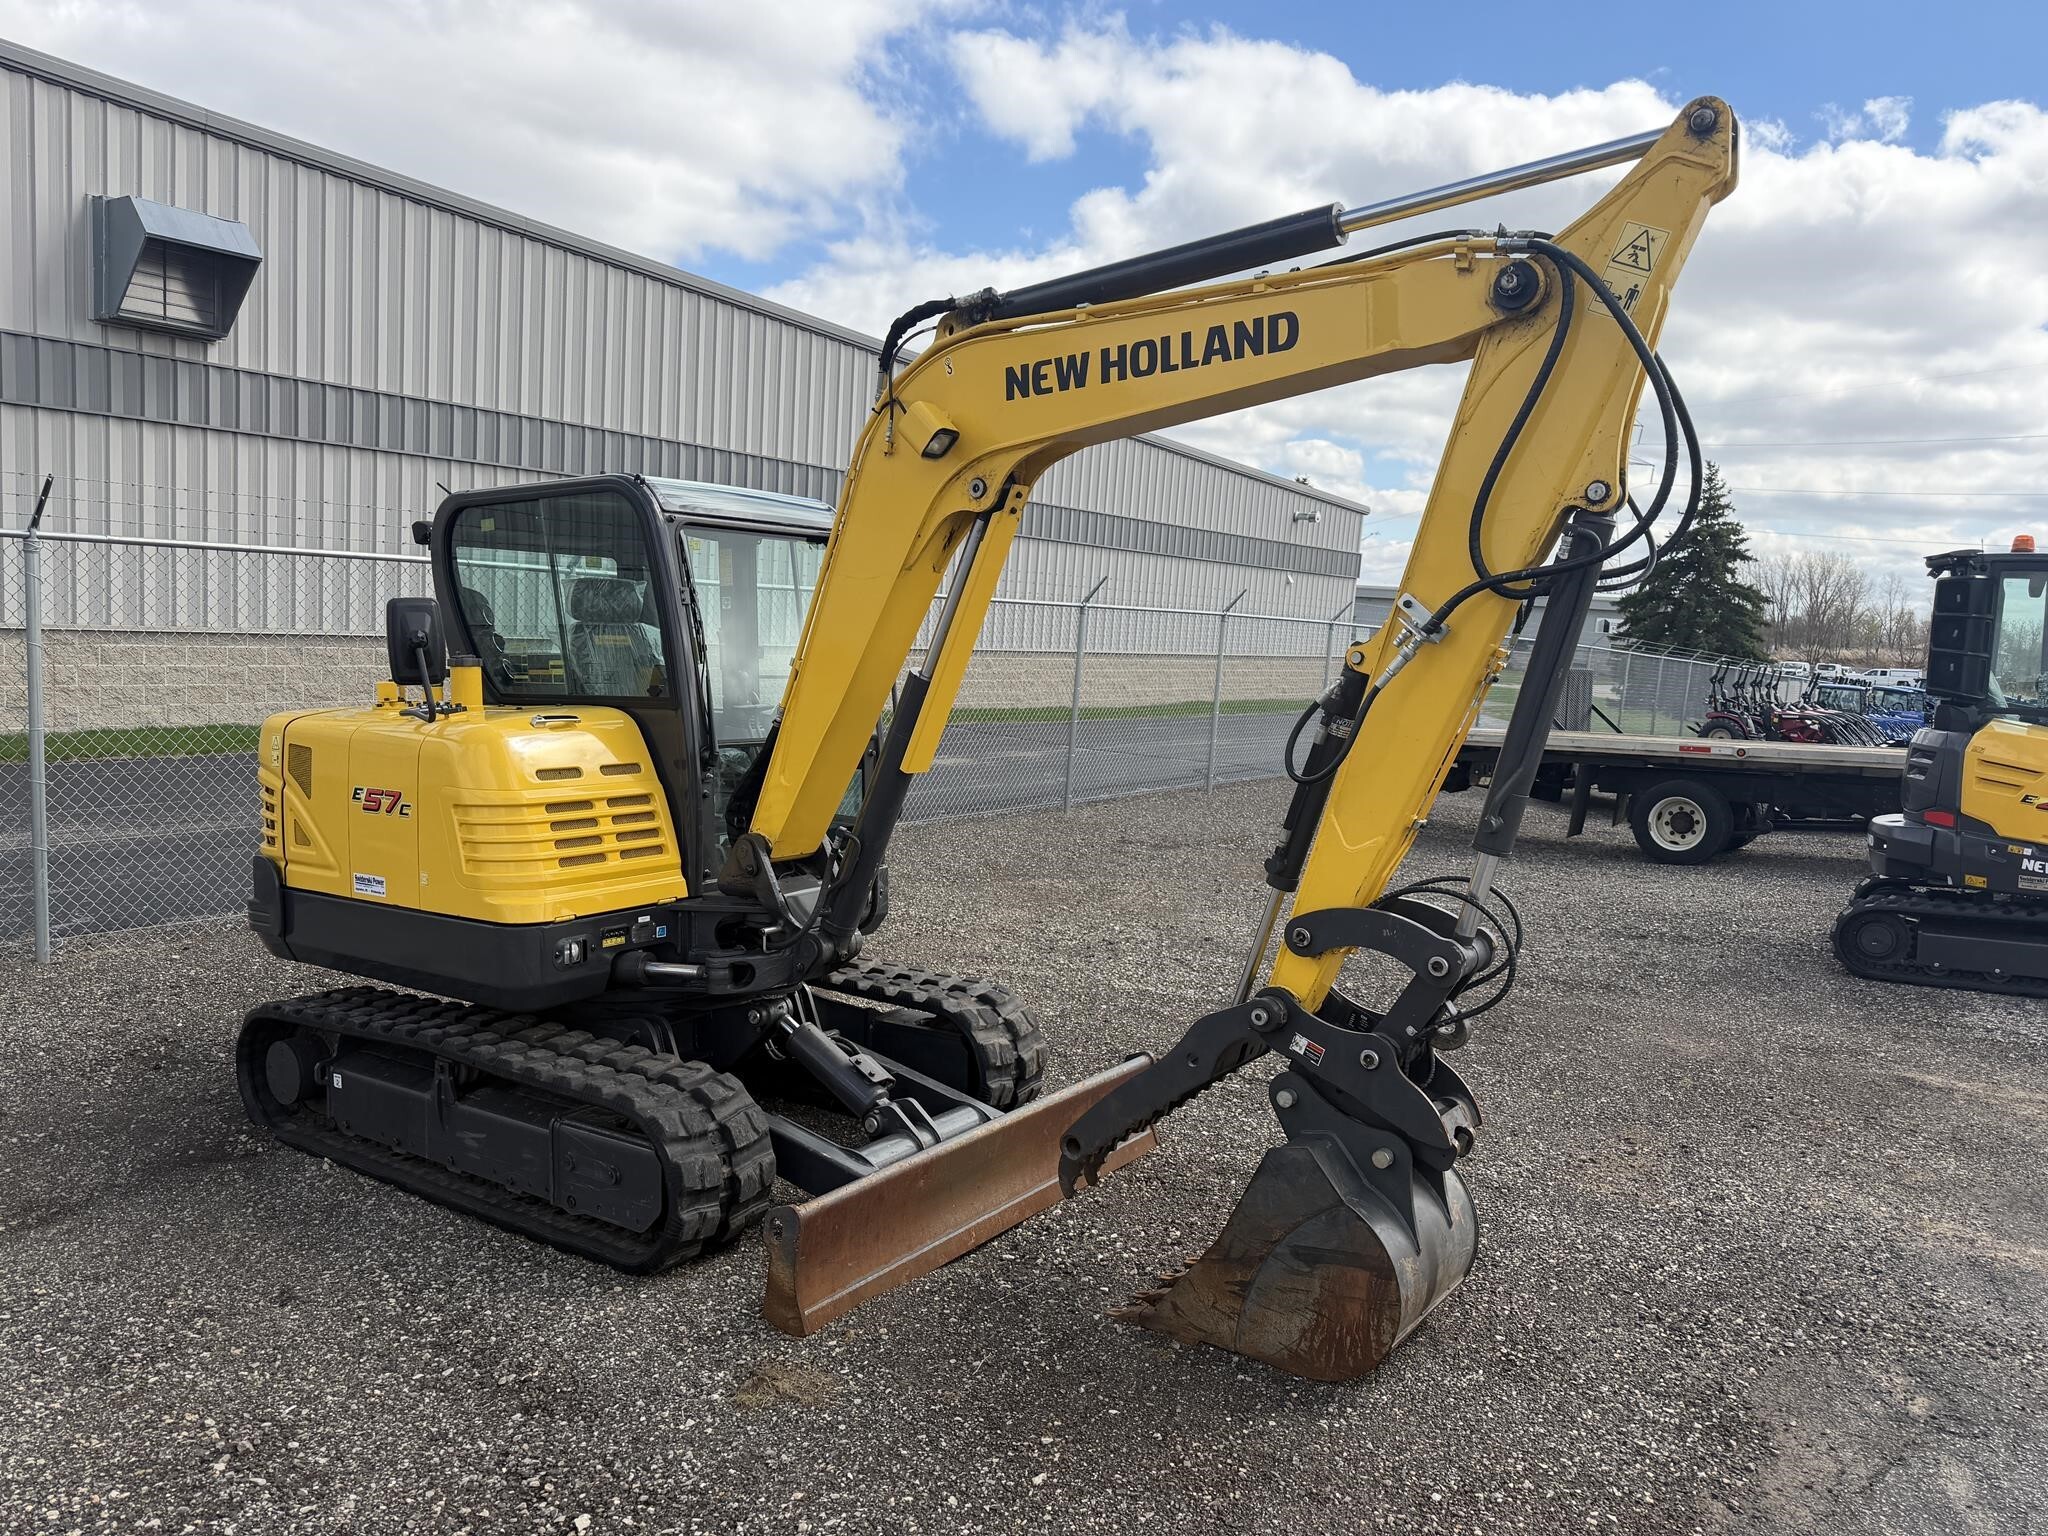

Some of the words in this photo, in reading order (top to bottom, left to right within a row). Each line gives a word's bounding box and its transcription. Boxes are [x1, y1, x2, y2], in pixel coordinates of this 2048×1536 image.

[1005, 352, 1090, 401] NEW
[1100, 311, 1300, 385] HOLLAND
[2021, 858, 2048, 874] NE
